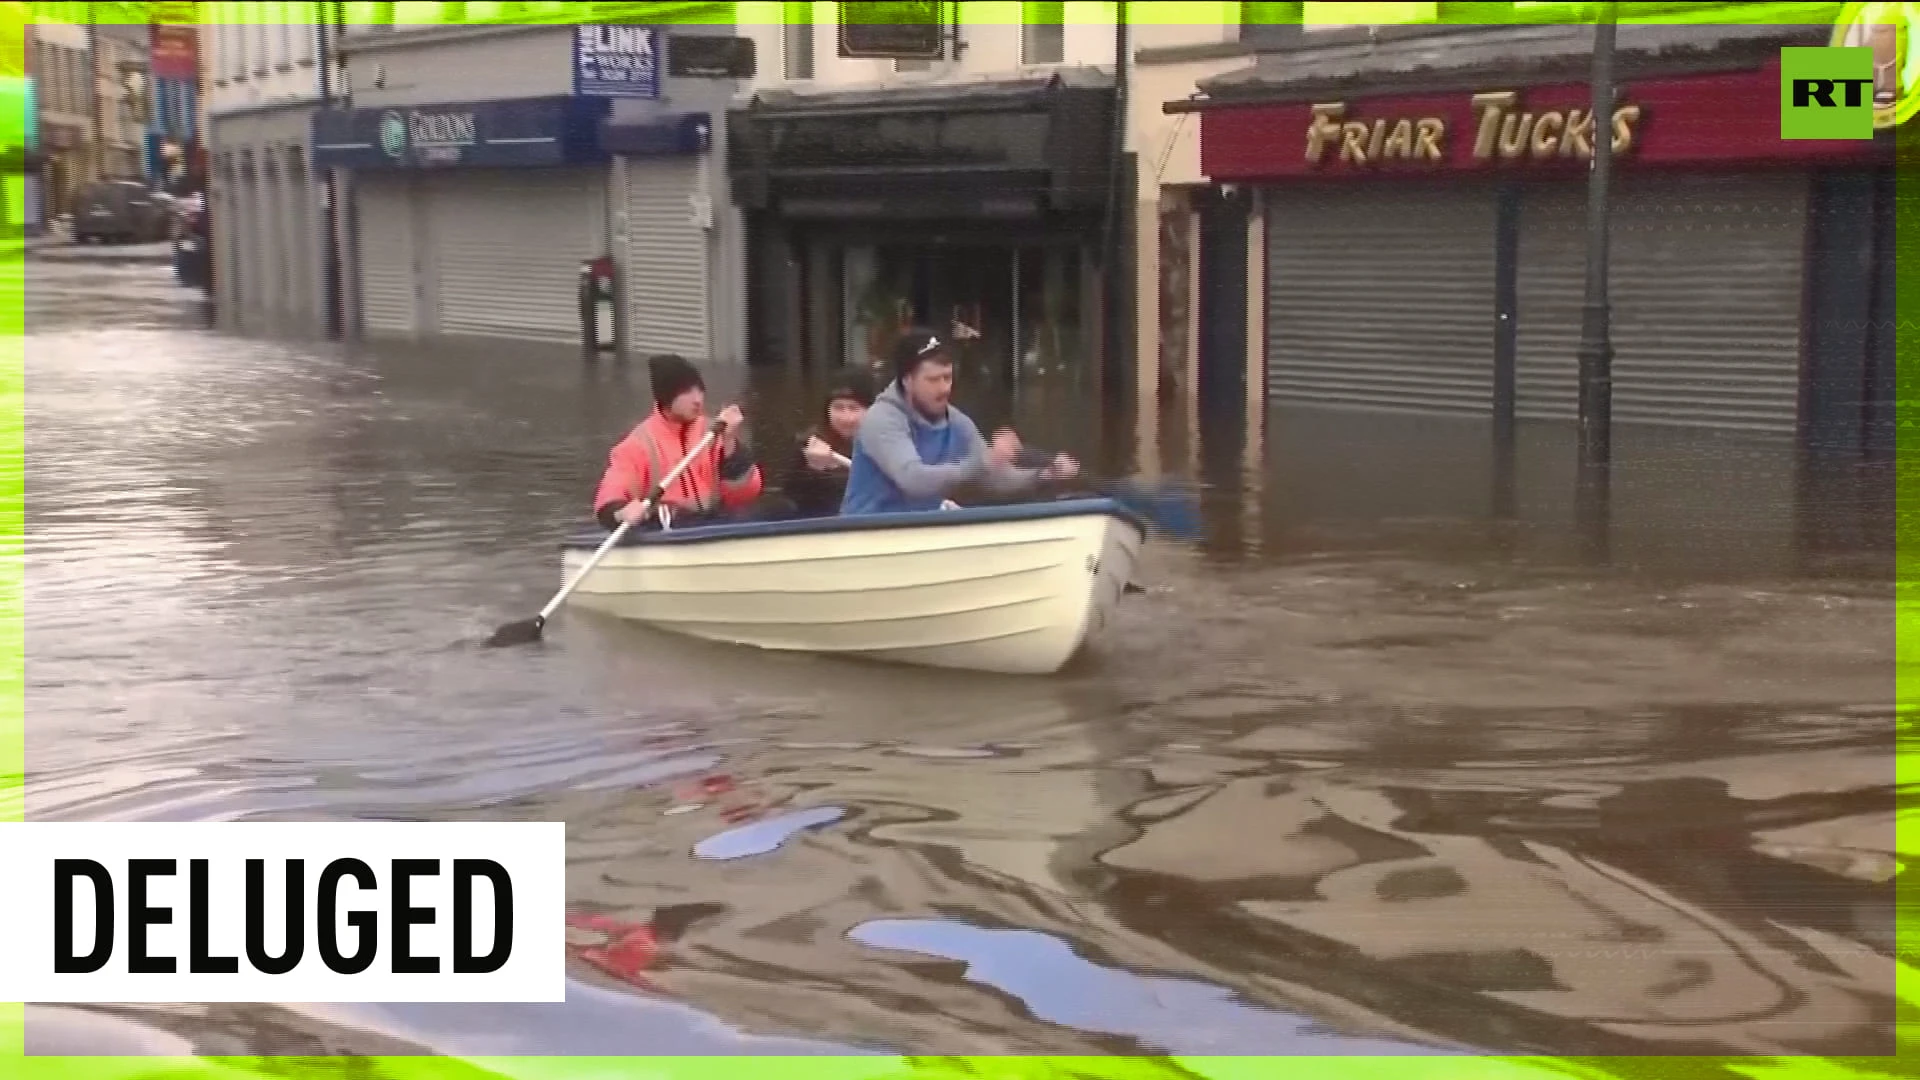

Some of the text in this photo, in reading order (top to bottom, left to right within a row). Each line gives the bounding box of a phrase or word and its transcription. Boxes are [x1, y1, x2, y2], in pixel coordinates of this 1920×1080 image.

[592, 24, 653, 54] LINK
[594, 54, 655, 70] WORKS
[1305, 101, 1445, 164] FRIAR
